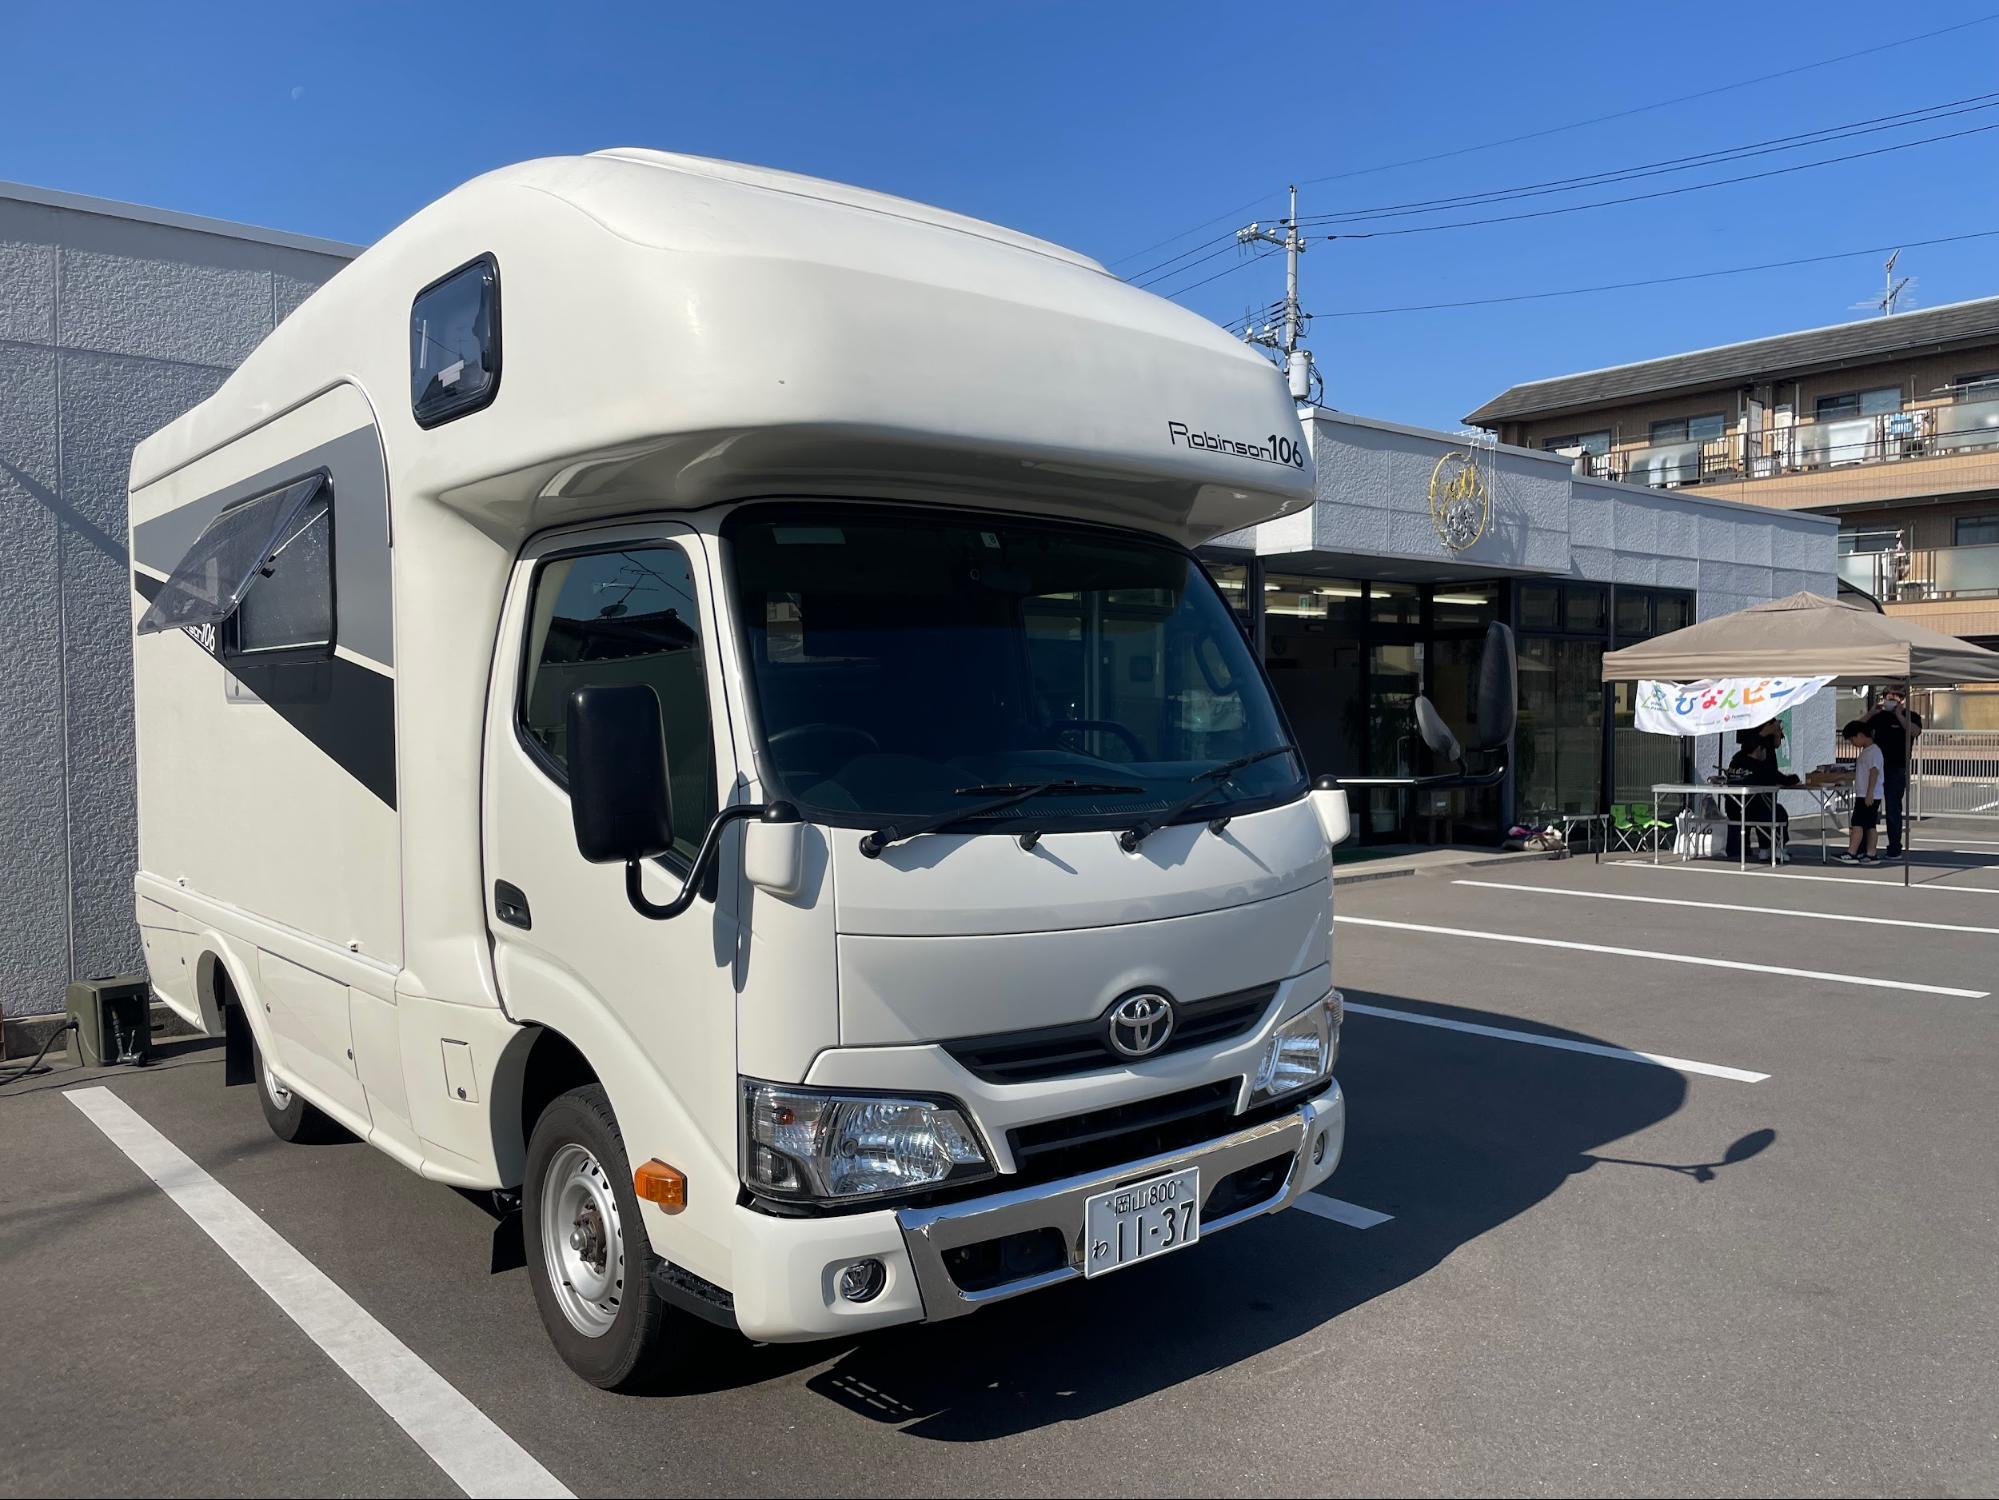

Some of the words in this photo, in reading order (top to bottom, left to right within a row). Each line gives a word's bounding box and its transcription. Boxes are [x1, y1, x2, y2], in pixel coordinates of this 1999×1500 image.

[1675, 679, 1814, 715] ひなんピン
[1092, 1239, 1109, 1260] わ
[1117, 1199, 1194, 1263] 11-37
